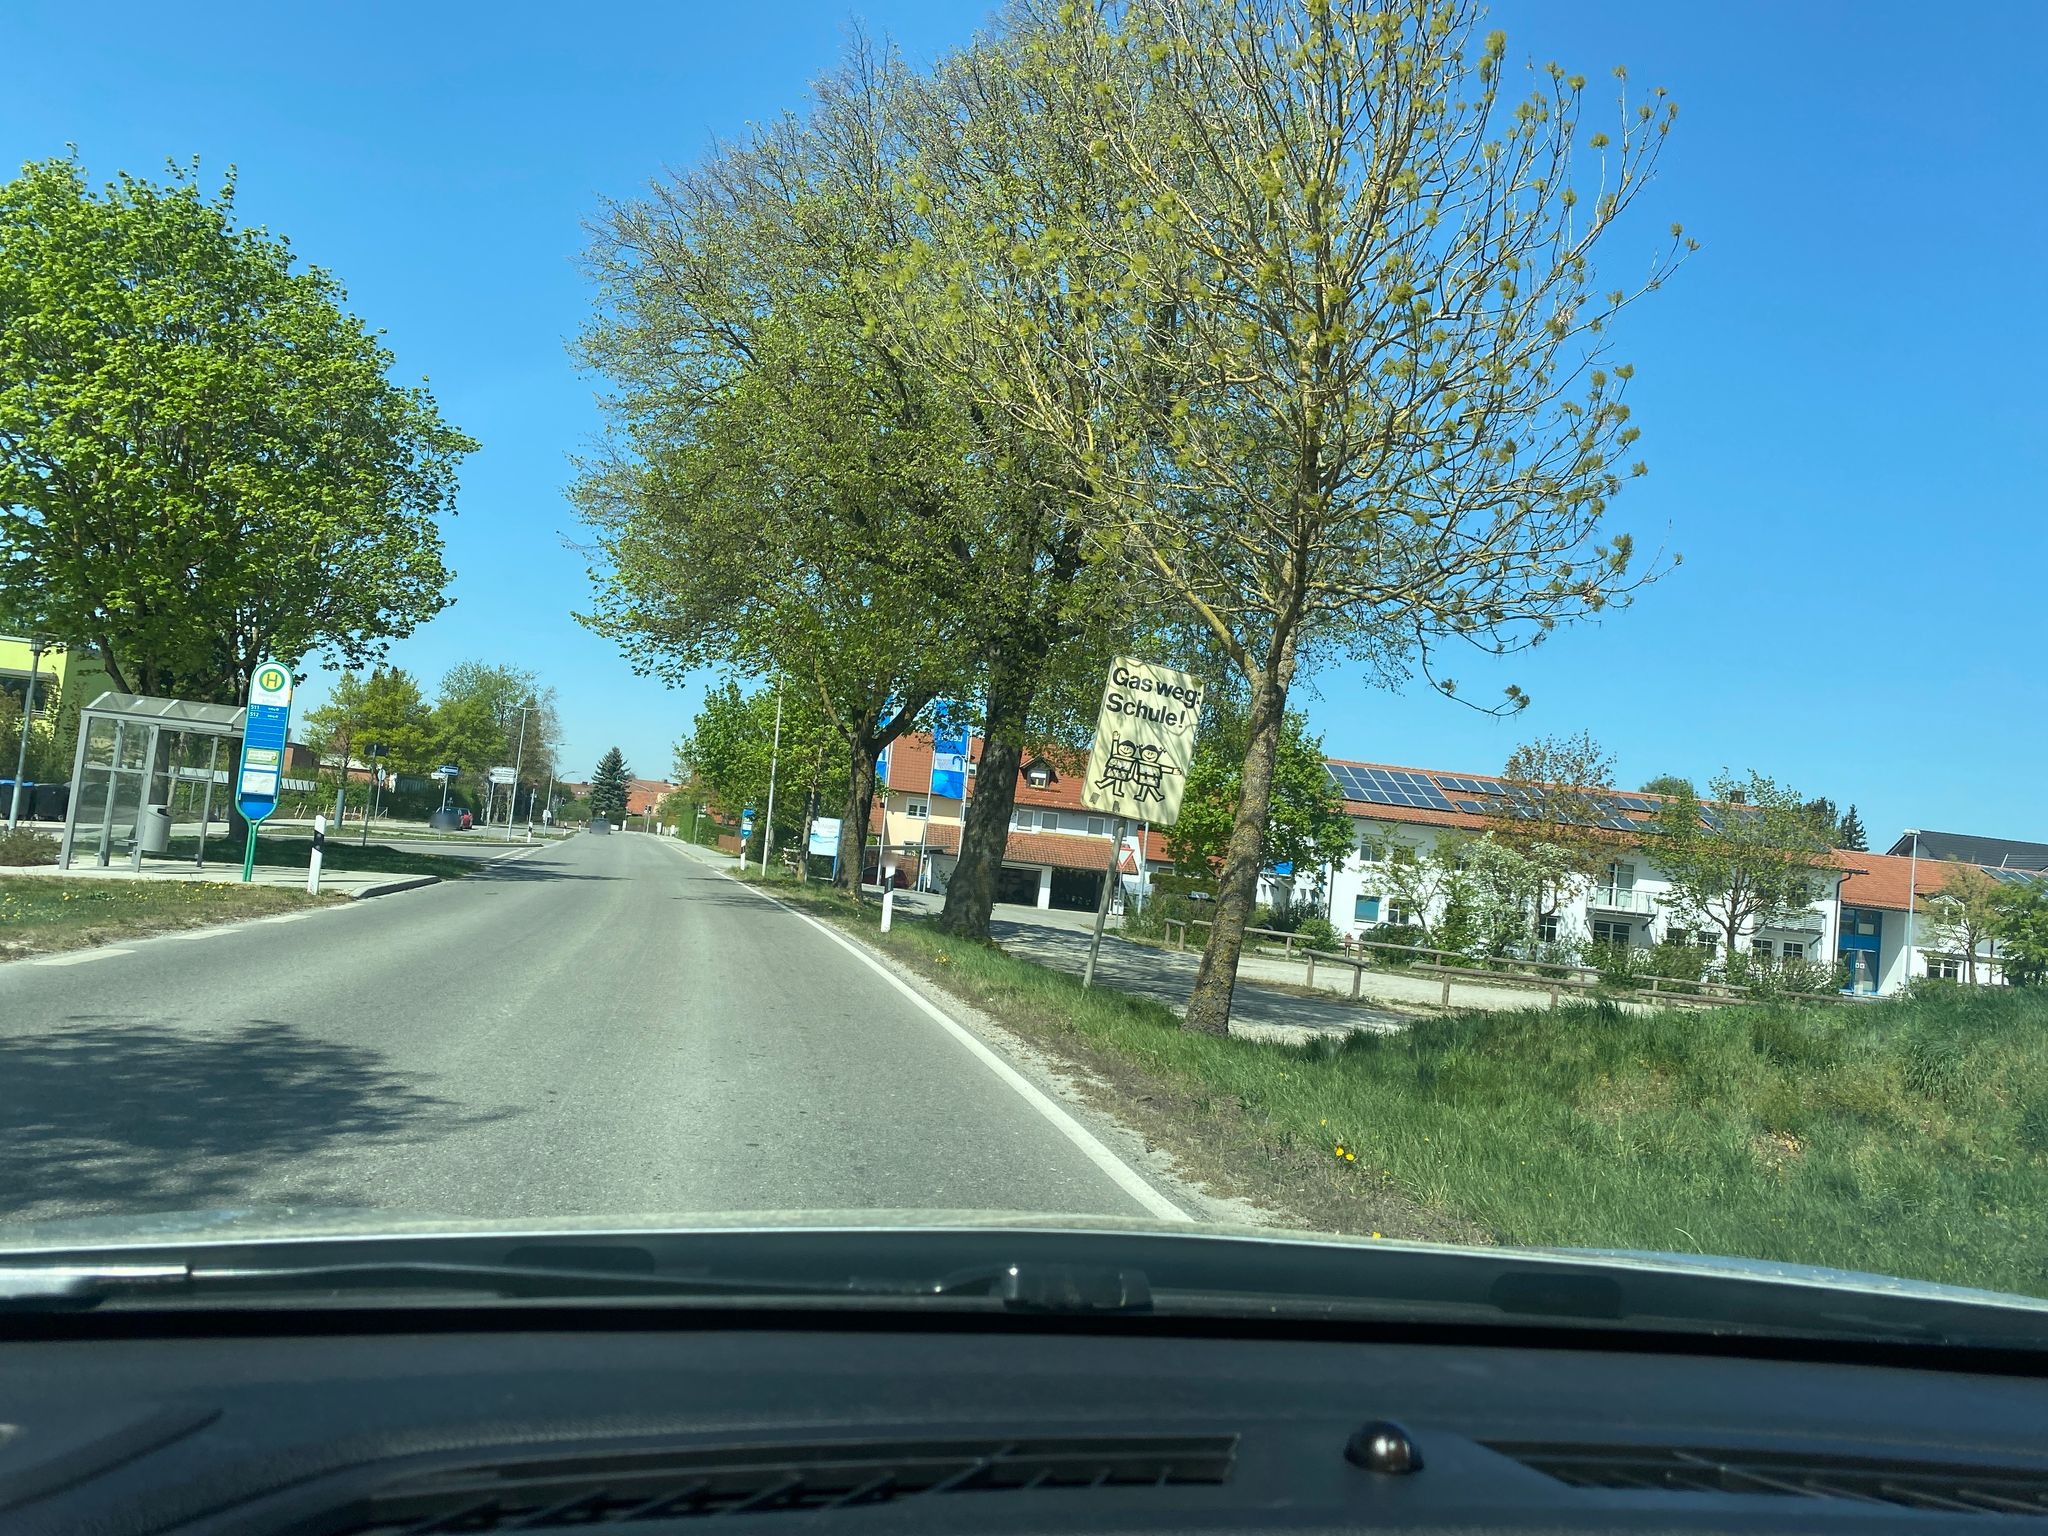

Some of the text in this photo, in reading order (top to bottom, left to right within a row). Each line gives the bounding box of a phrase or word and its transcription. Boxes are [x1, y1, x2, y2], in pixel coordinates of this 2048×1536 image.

[266, 674, 278, 688] H
[1112, 667, 1202, 709] Gas weg:
[1106, 693, 1186, 728] Schule!
